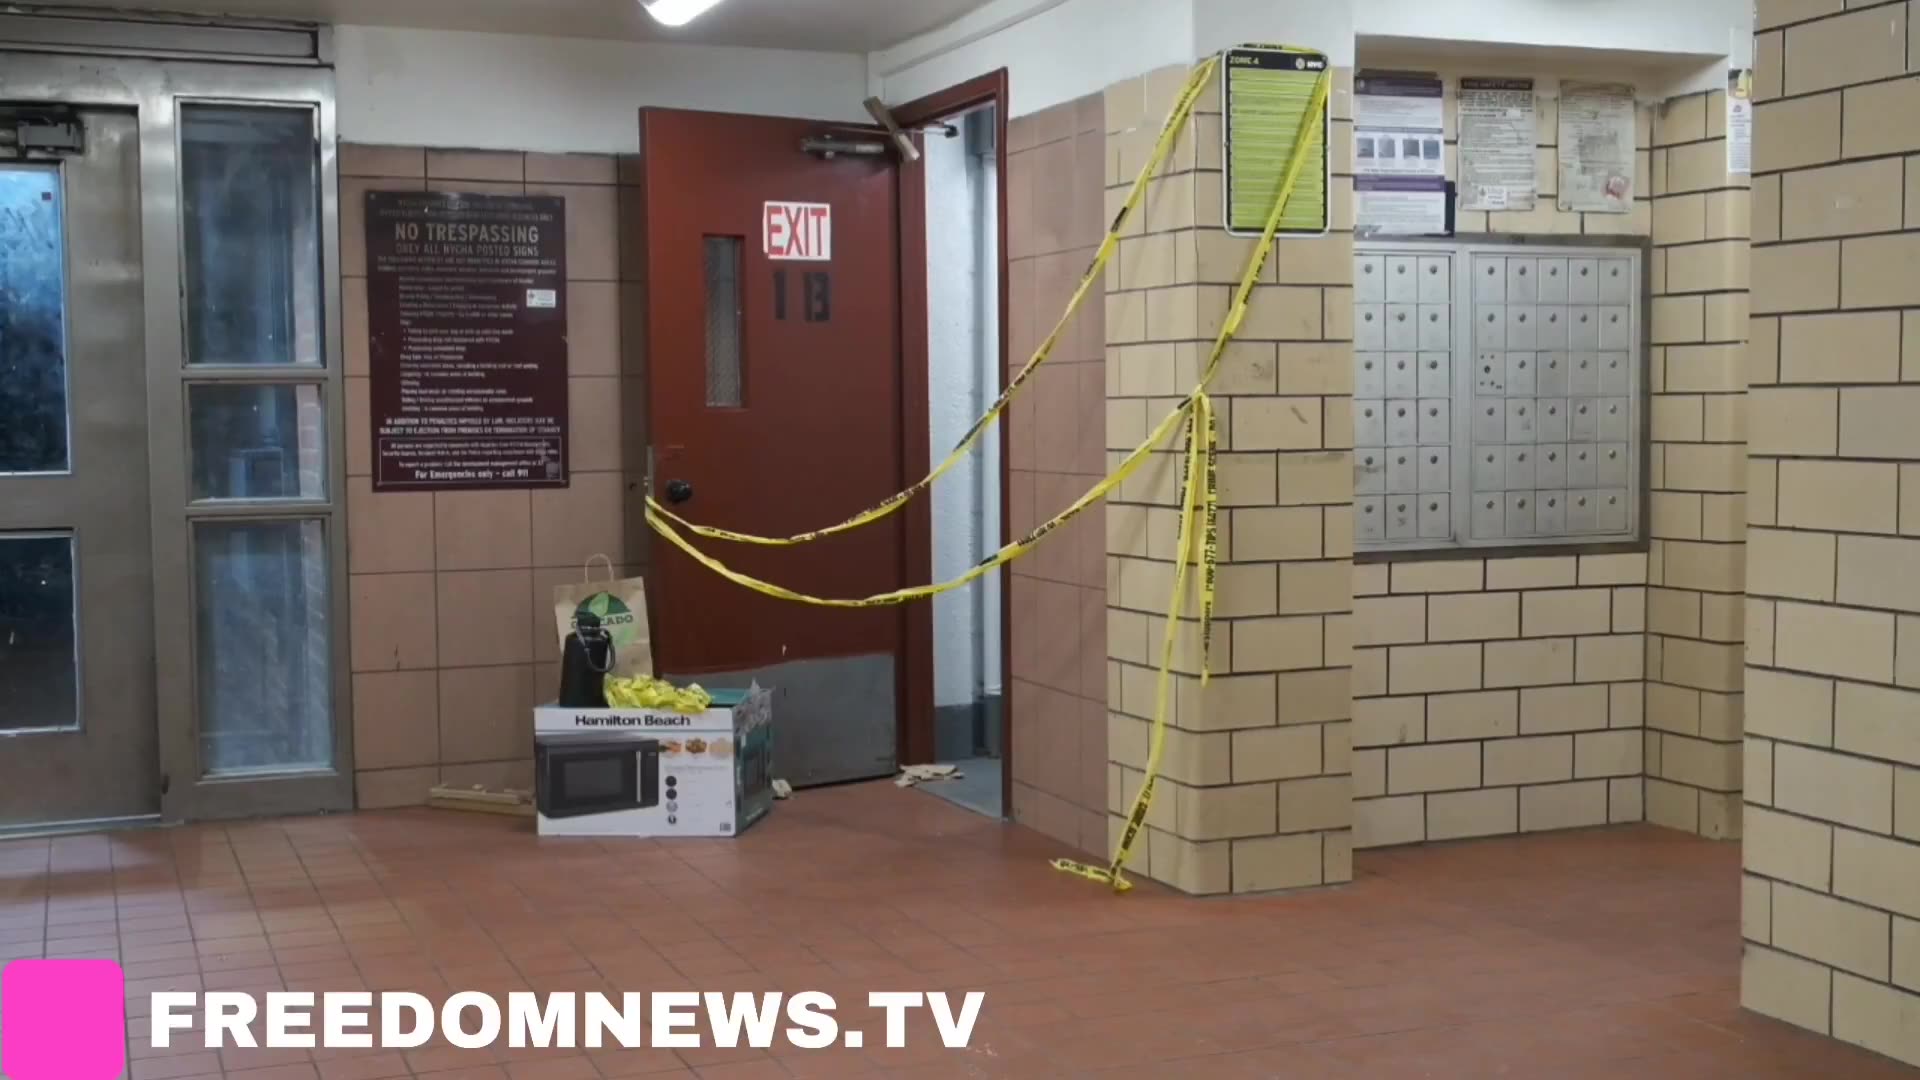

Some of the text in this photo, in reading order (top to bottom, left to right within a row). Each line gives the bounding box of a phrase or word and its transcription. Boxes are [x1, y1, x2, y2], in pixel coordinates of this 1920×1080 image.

[395, 222, 540, 244] NO TRESPASSING
[766, 205, 828, 257] EXIT
[423, 243, 440, 255] ALL
[442, 243, 473, 256] NYCHA
[476, 244, 511, 257] POSTED
[512, 245, 540, 257] SIGNS
[415, 469, 428, 479] For
[429, 469, 476, 481] Emergencies
[477, 469, 493, 480] only
[502, 468, 516, 478] call
[516, 468, 529, 478] 911
[575, 714, 691, 727] Hamilton Beach
